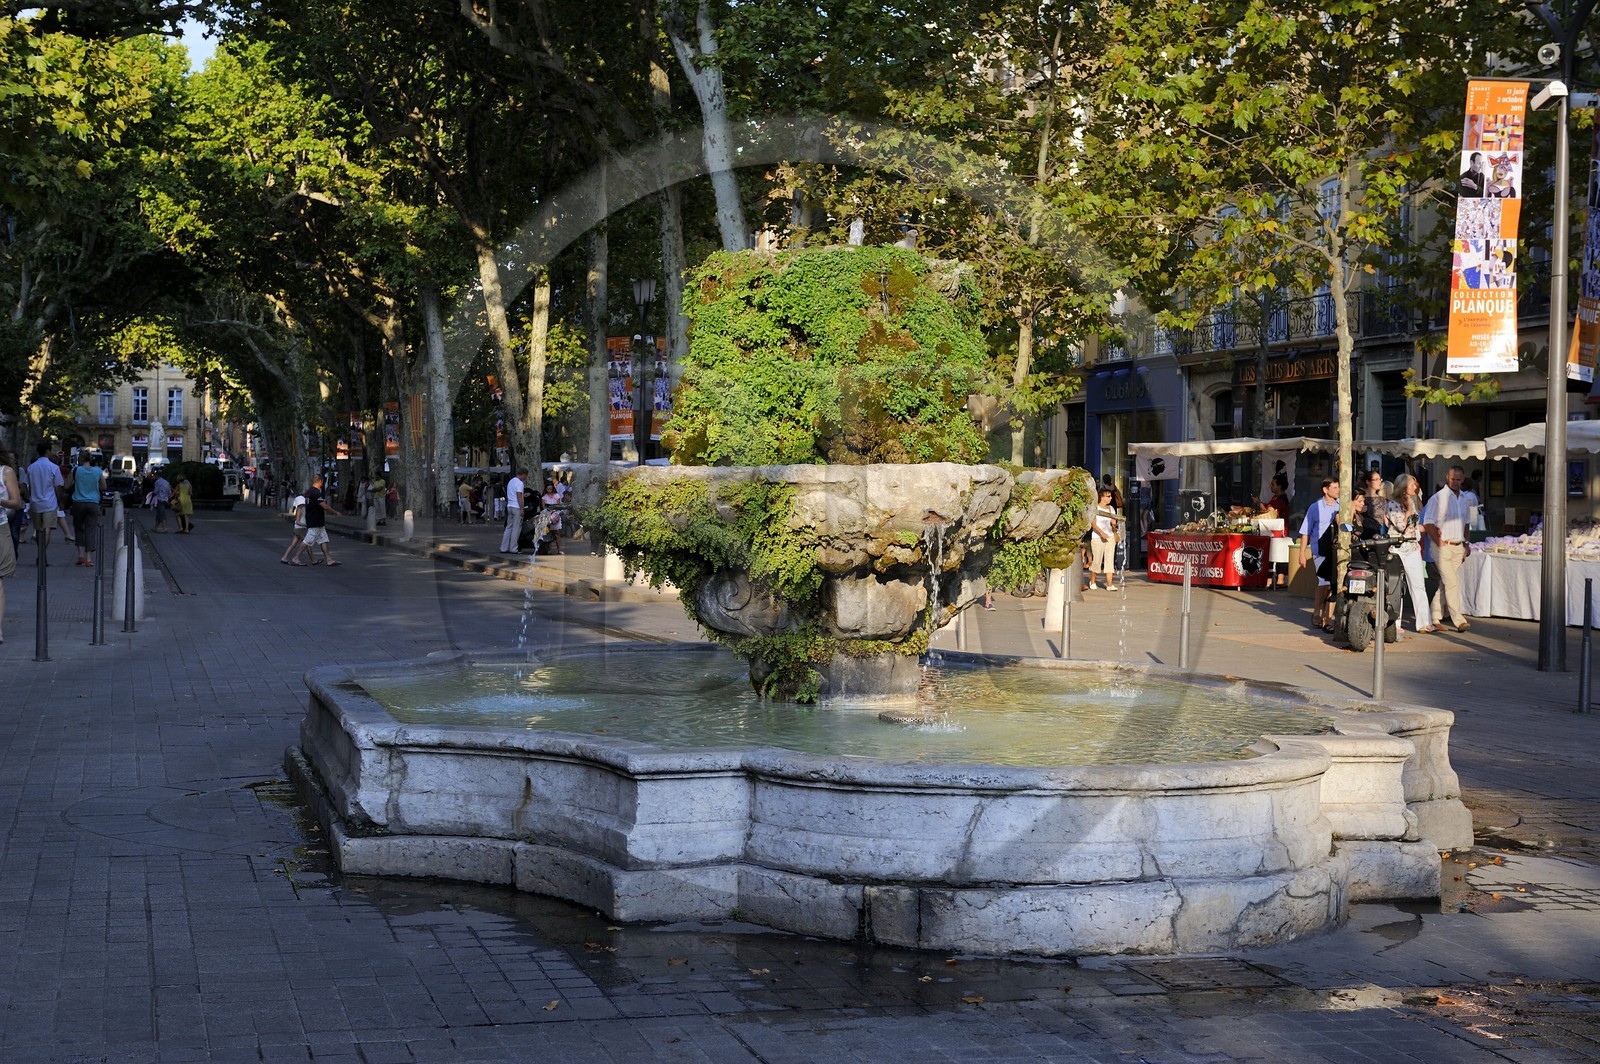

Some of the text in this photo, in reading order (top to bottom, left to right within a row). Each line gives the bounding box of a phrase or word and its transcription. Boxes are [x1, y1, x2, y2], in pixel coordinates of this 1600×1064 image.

[1512, 88, 1525, 96] juin
[1454, 291, 1513, 299] COLLECTION
[1453, 299, 1514, 316] PLANQUE
[1239, 357, 1337, 381] LES MIS DES ARTS
[1155, 539, 1175, 550] VENTE
[1183, 541, 1224, 552] VERITABLES
[1166, 551, 1209, 565] PRODUITS ET
